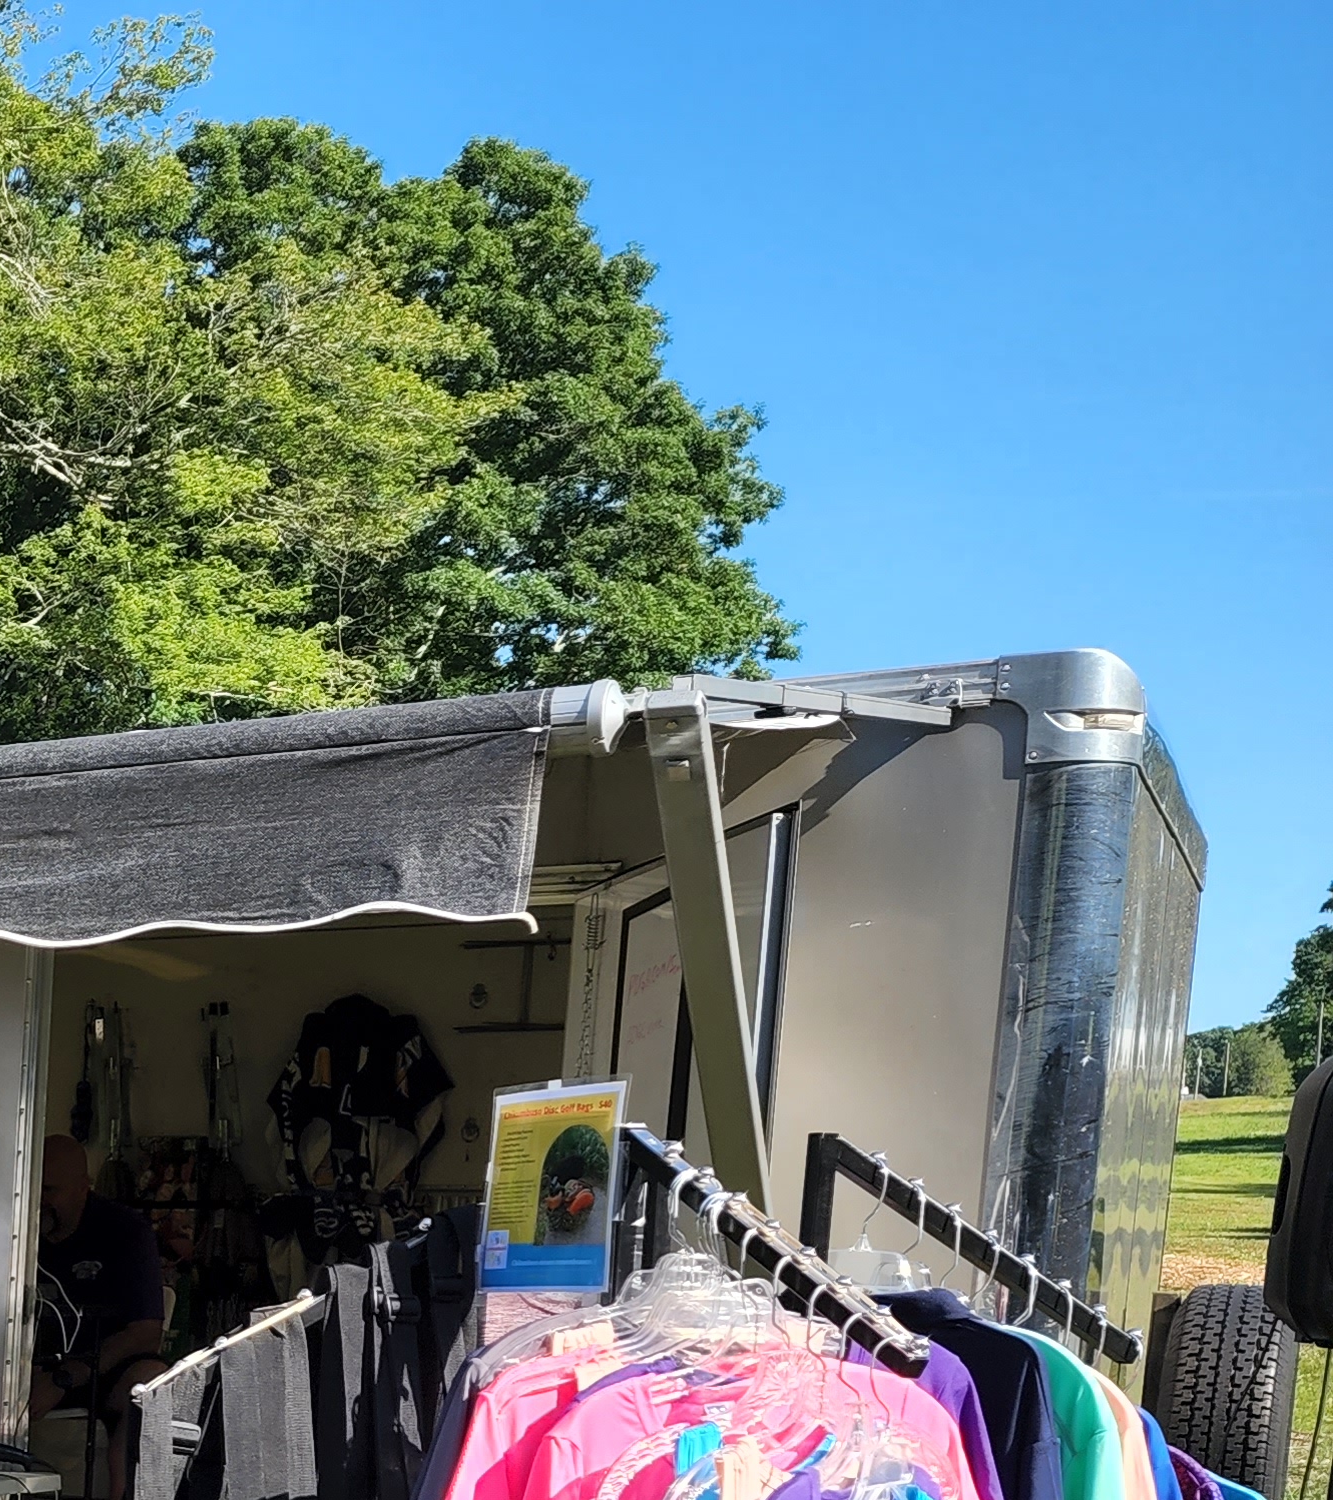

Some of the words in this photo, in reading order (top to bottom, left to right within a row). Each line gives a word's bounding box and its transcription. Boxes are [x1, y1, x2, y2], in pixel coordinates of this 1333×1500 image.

[544, 1106, 559, 1116] Disc
[561, 1103, 575, 1114] Golf
[576, 1102, 594, 1113] Bags
